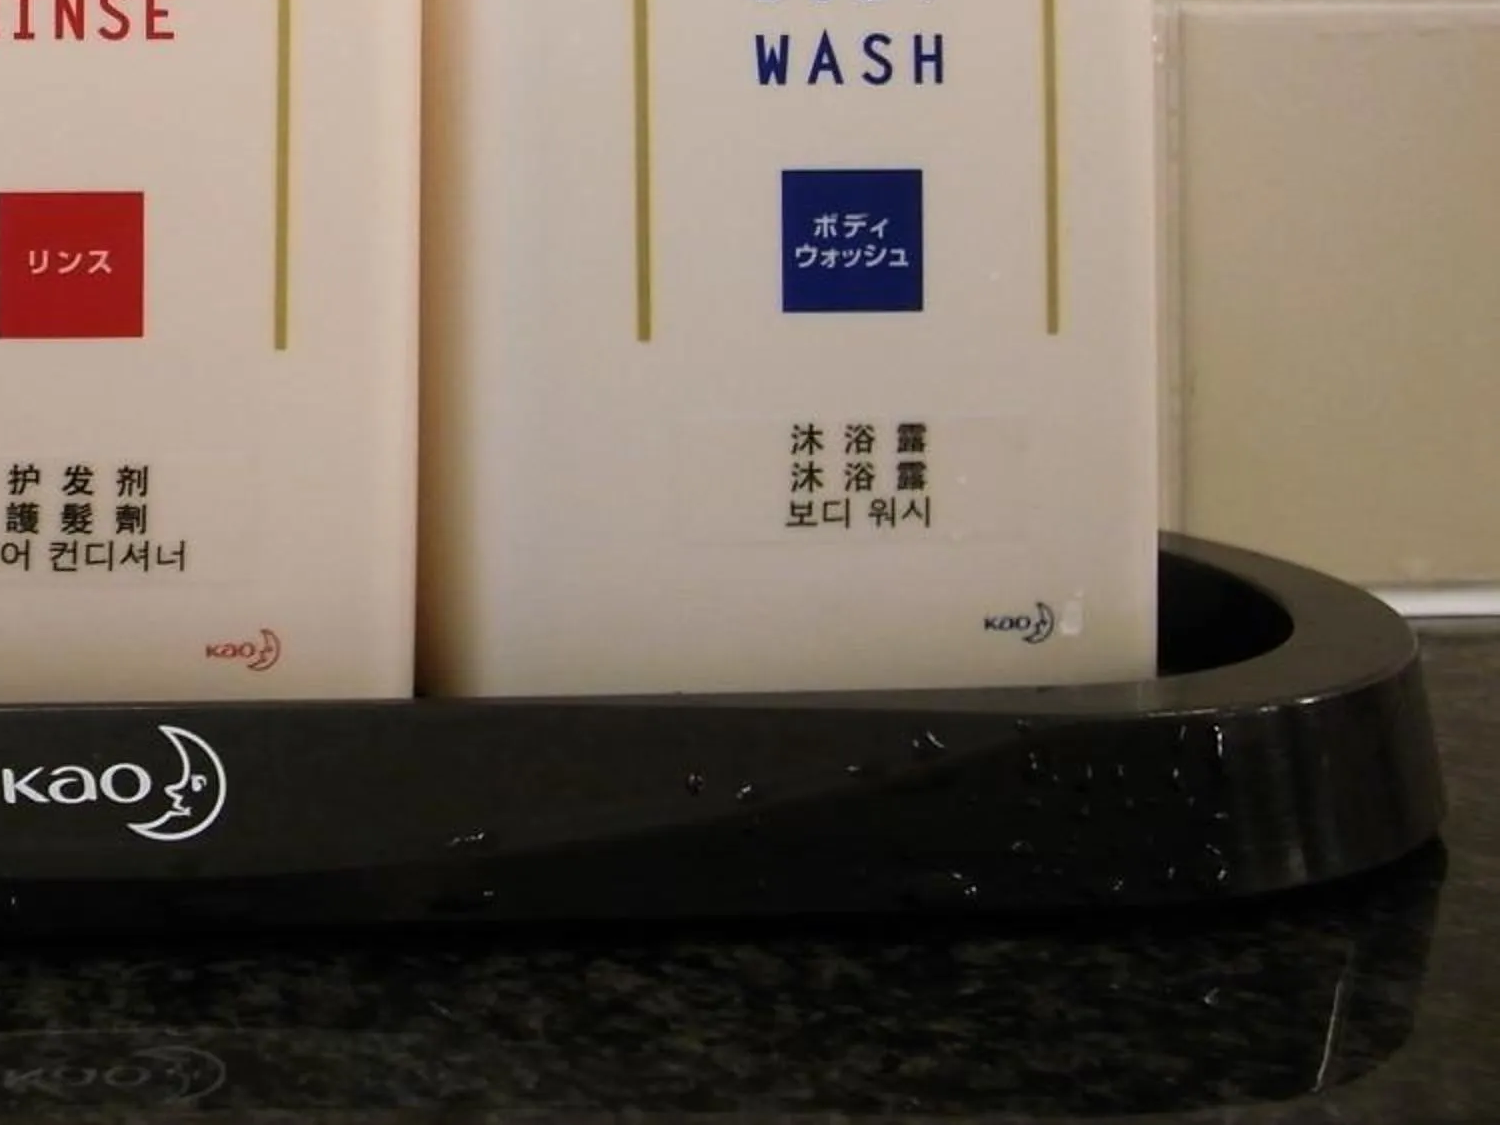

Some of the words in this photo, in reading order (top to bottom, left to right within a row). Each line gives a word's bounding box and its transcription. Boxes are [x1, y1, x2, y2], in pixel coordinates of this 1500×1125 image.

[755, 29, 944, 85] WASH
[813, 213, 890, 239] ボディ
[28, 249, 113, 275] リンス
[794, 244, 909, 269] ウォッシュ
[790, 423, 928, 456] 沐浴露
[7, 464, 149, 497] 护发剂
[785, 498, 851, 529] 보디
[868, 497, 932, 528] 워시
[49, 539, 187, 572] 컨디셔너
